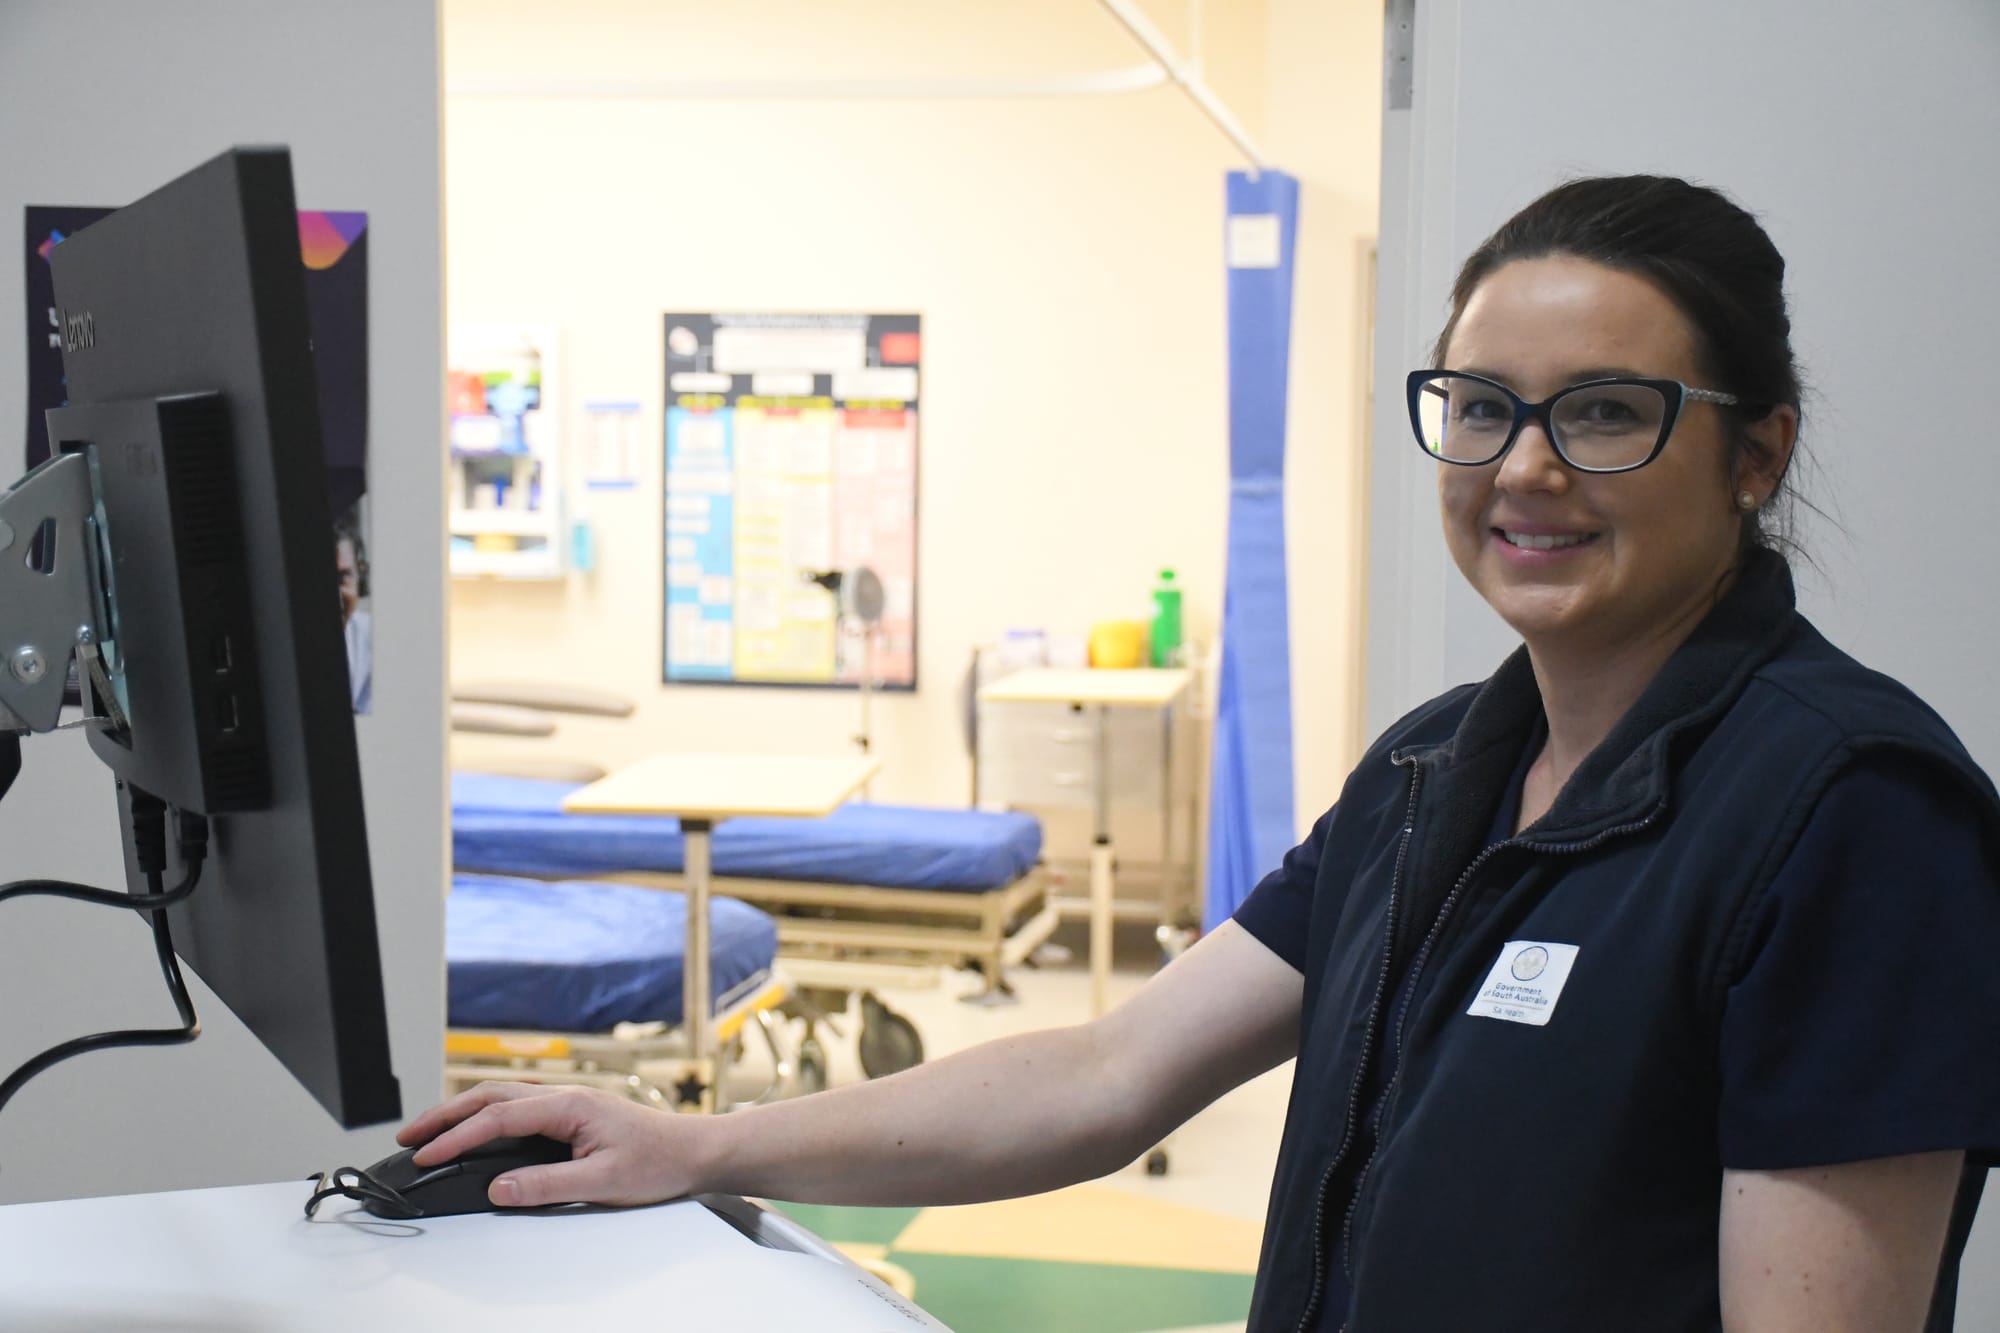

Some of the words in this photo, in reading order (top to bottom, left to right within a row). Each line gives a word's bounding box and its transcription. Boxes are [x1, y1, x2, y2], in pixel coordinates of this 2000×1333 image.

[63, 307, 95, 352] Lenovo
[1491, 989, 1513, 999] South
[1514, 993, 1548, 1005] Australia
[1495, 982, 1542, 996] Government
